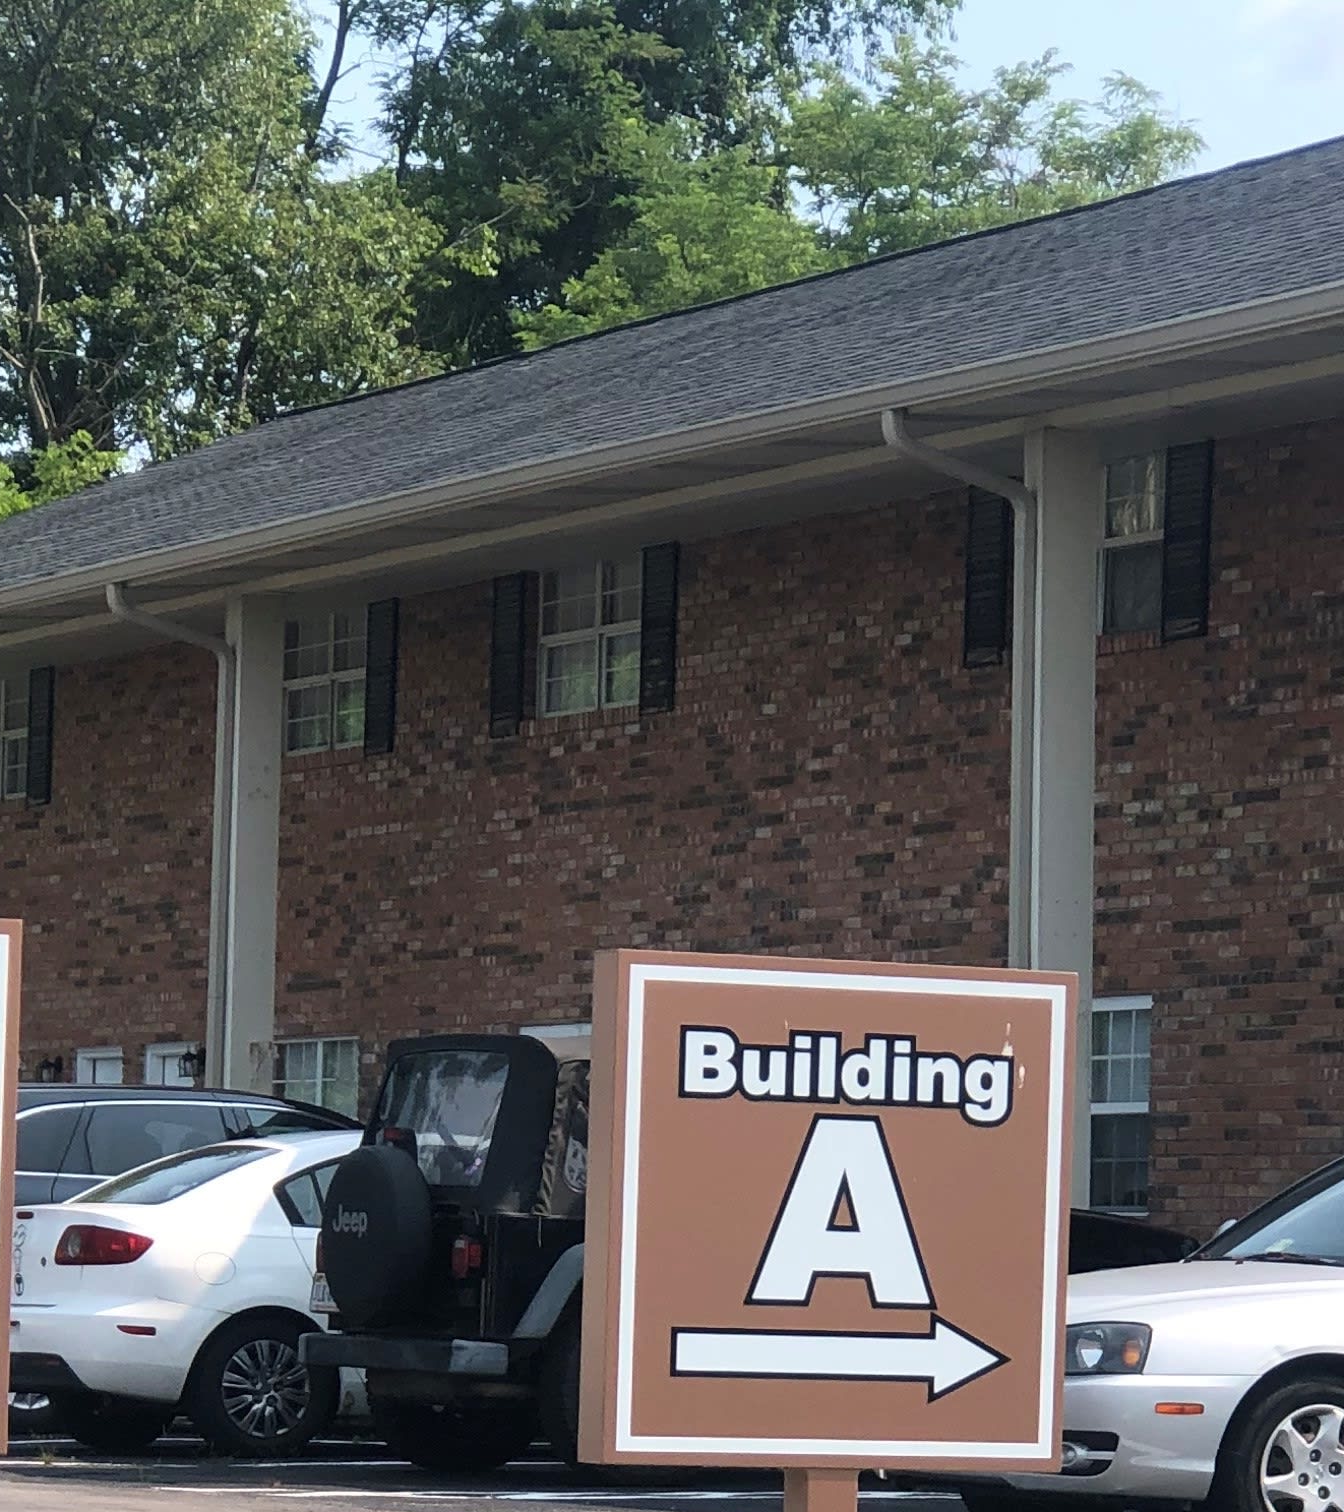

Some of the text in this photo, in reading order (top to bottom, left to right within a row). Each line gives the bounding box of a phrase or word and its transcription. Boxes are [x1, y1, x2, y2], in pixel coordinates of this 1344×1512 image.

[679, 1025, 1014, 1127] Building
[332, 1203, 368, 1239] Jeep
[743, 1113, 938, 1310] A
